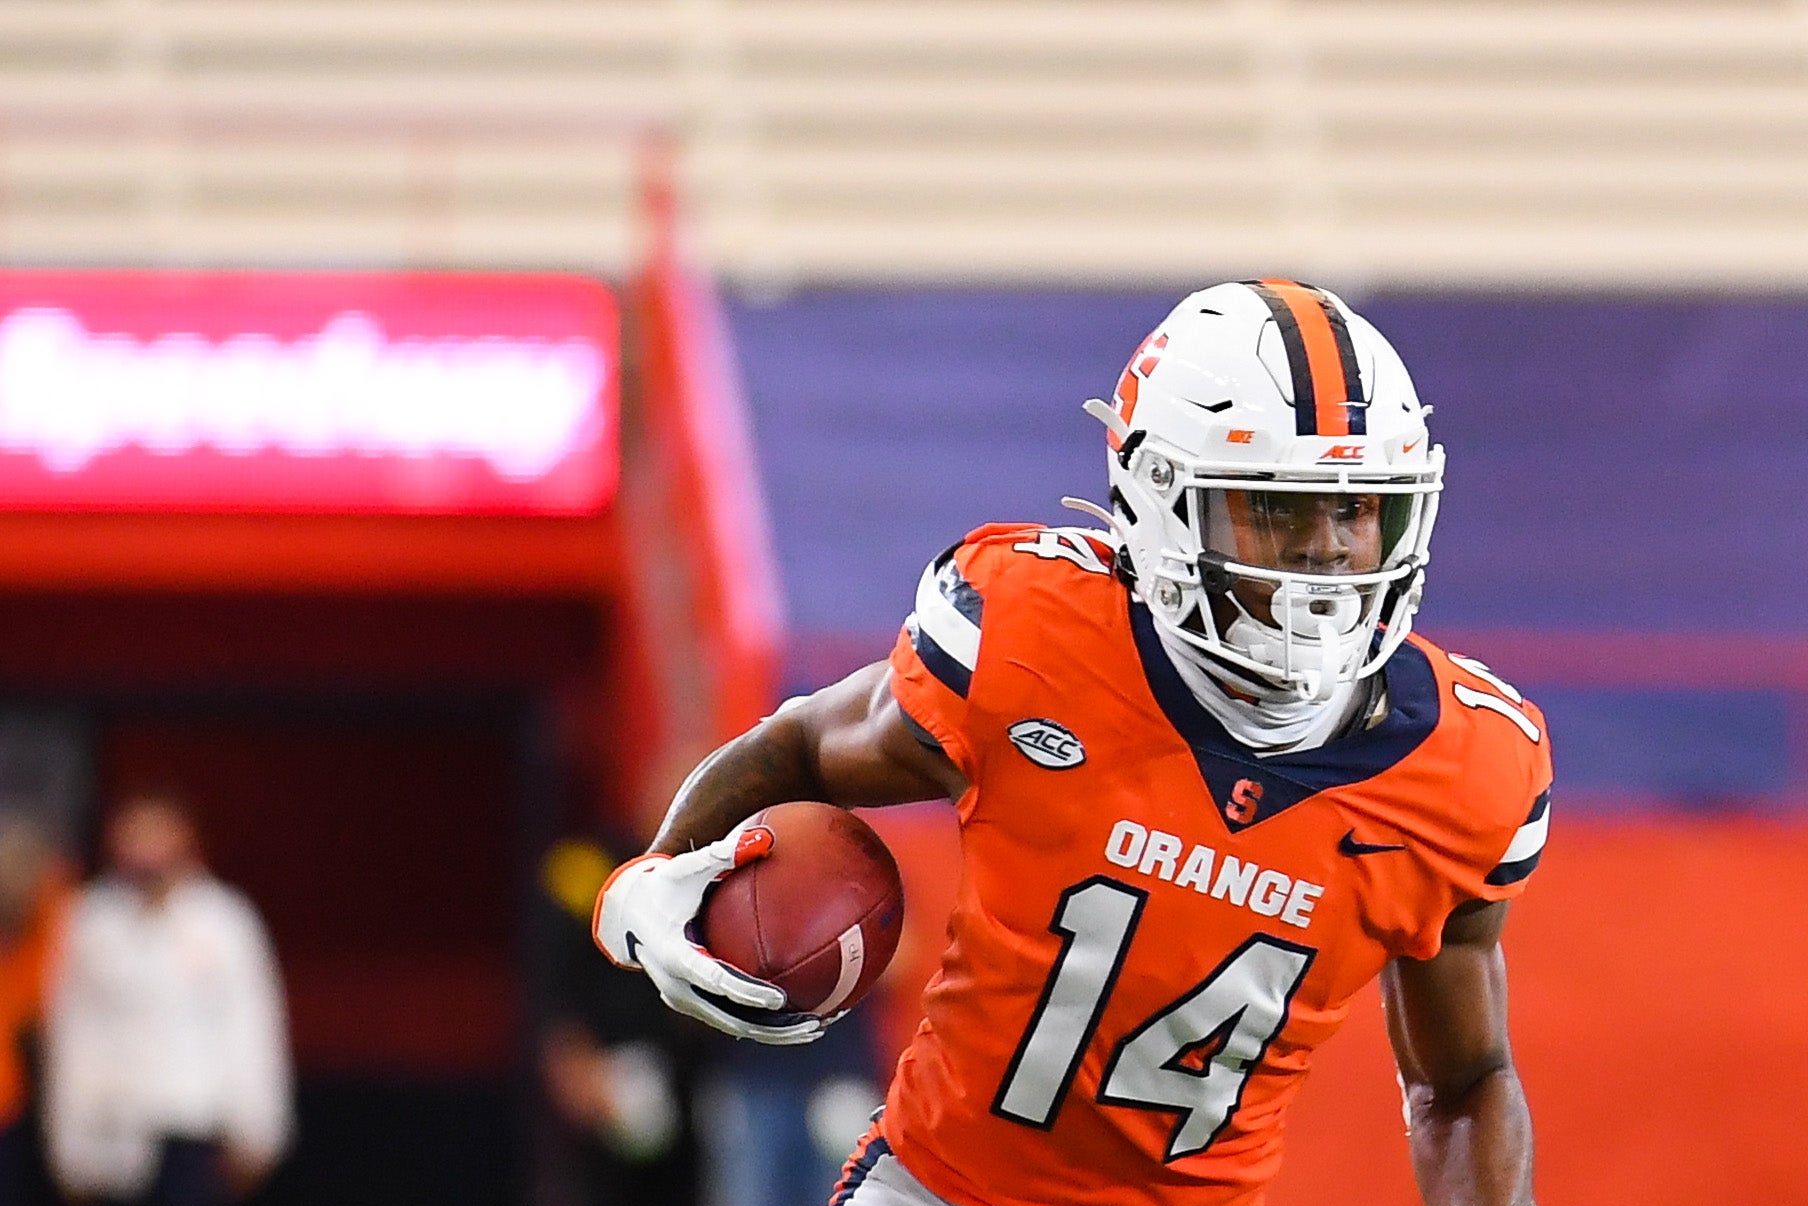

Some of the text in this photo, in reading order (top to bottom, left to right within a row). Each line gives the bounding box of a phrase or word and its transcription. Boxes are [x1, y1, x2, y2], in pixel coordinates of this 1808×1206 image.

[1319, 445, 1366, 460] ACC
[1018, 729, 1079, 758] ACC
[1225, 777, 1264, 824] S
[1104, 819, 1325, 929] ORANGE
[990, 874, 1317, 1163] 14
